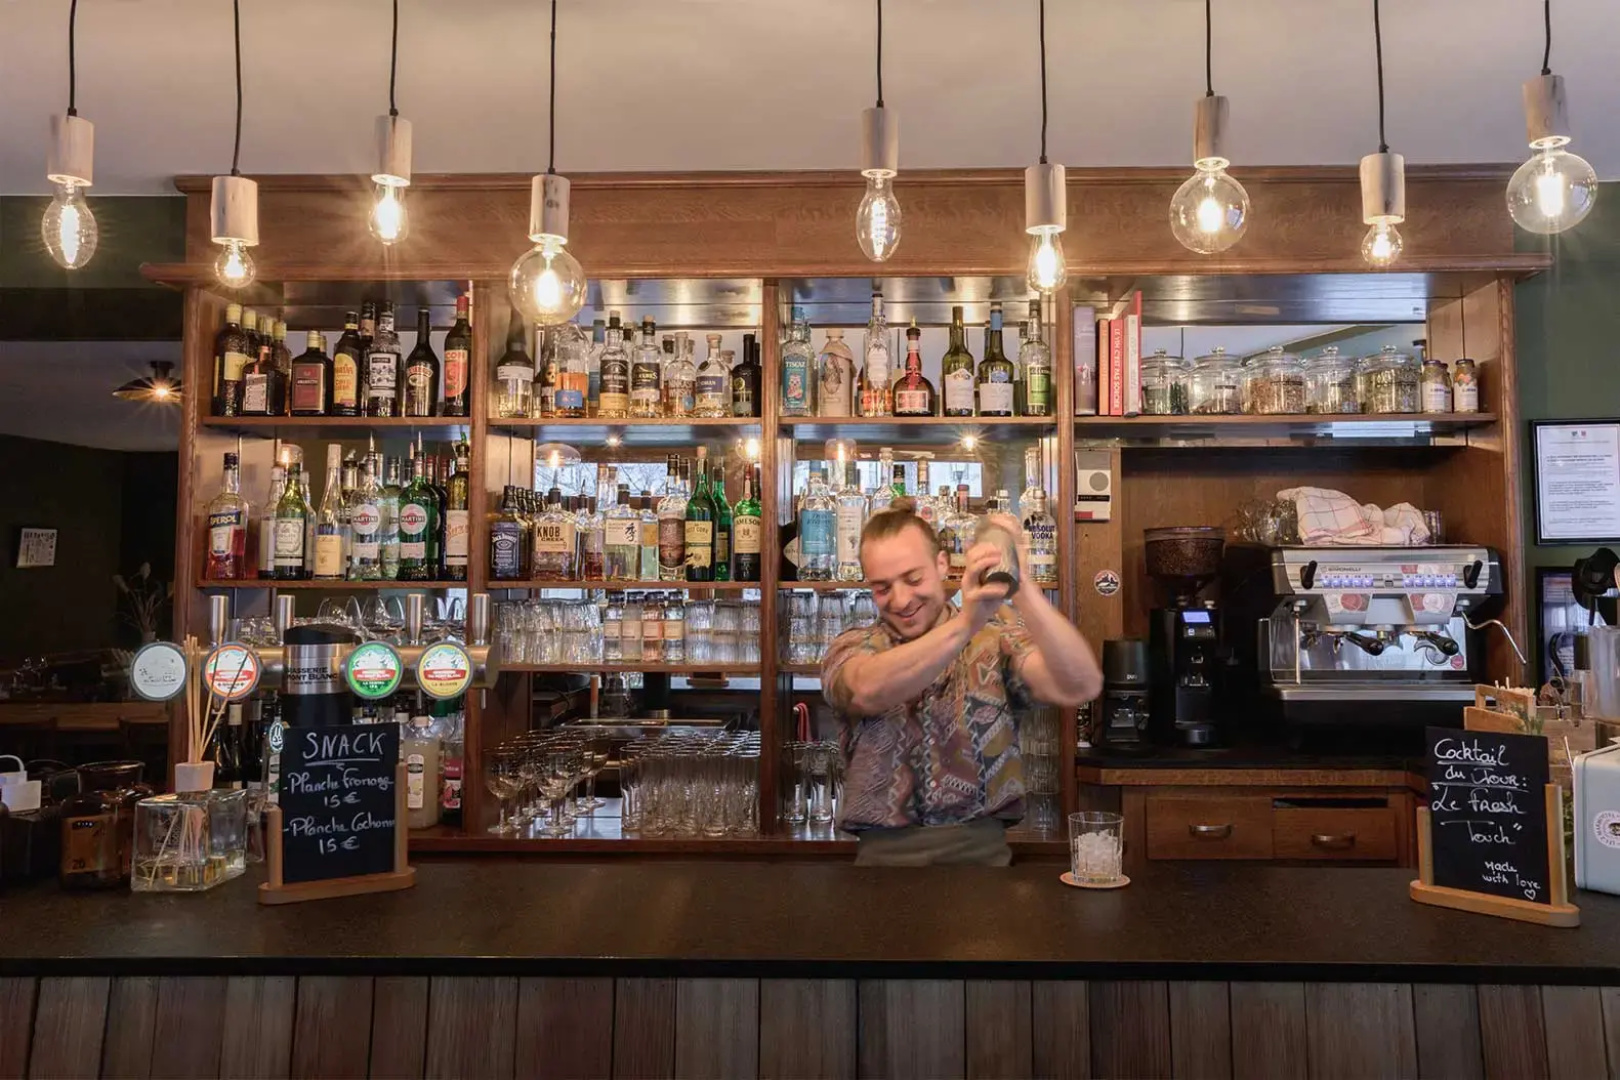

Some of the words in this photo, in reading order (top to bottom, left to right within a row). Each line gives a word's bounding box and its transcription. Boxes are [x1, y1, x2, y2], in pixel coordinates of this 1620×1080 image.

[536, 526, 560, 537] KNOB
[302, 732, 387, 760] SNACK
[1434, 738, 1510, 766] Cocktail
[1444, 765, 1466, 780] du
